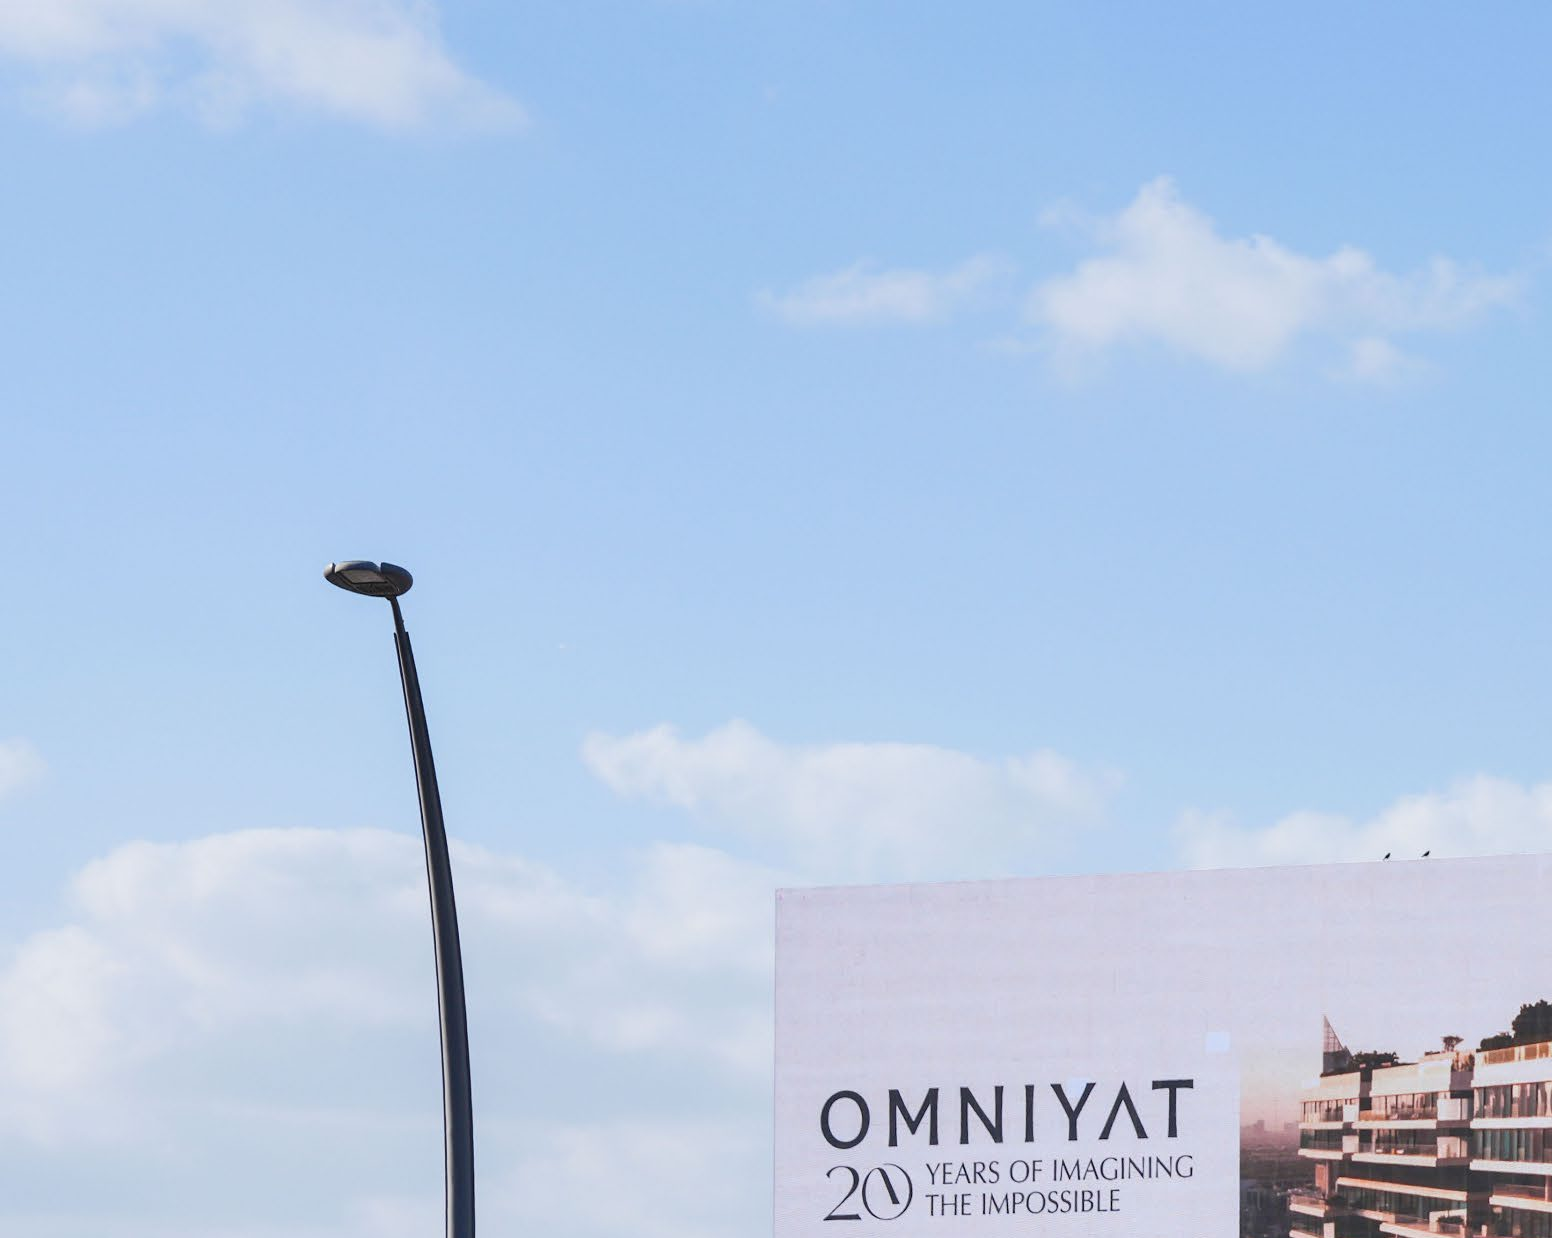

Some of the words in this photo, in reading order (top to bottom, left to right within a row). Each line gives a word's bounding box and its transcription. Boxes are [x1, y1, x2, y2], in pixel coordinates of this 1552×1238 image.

[819, 1078, 1194, 1150] OMNIYAT
[822, 1163, 914, 1222] 20
[925, 1160, 1000, 1186] YEARS
[1009, 1159, 1043, 1184] OF
[1053, 1154, 1194, 1182] IMAGINING
[924, 1193, 972, 1217] THE
[982, 1188, 1121, 1216] IMPOSSIBLE
